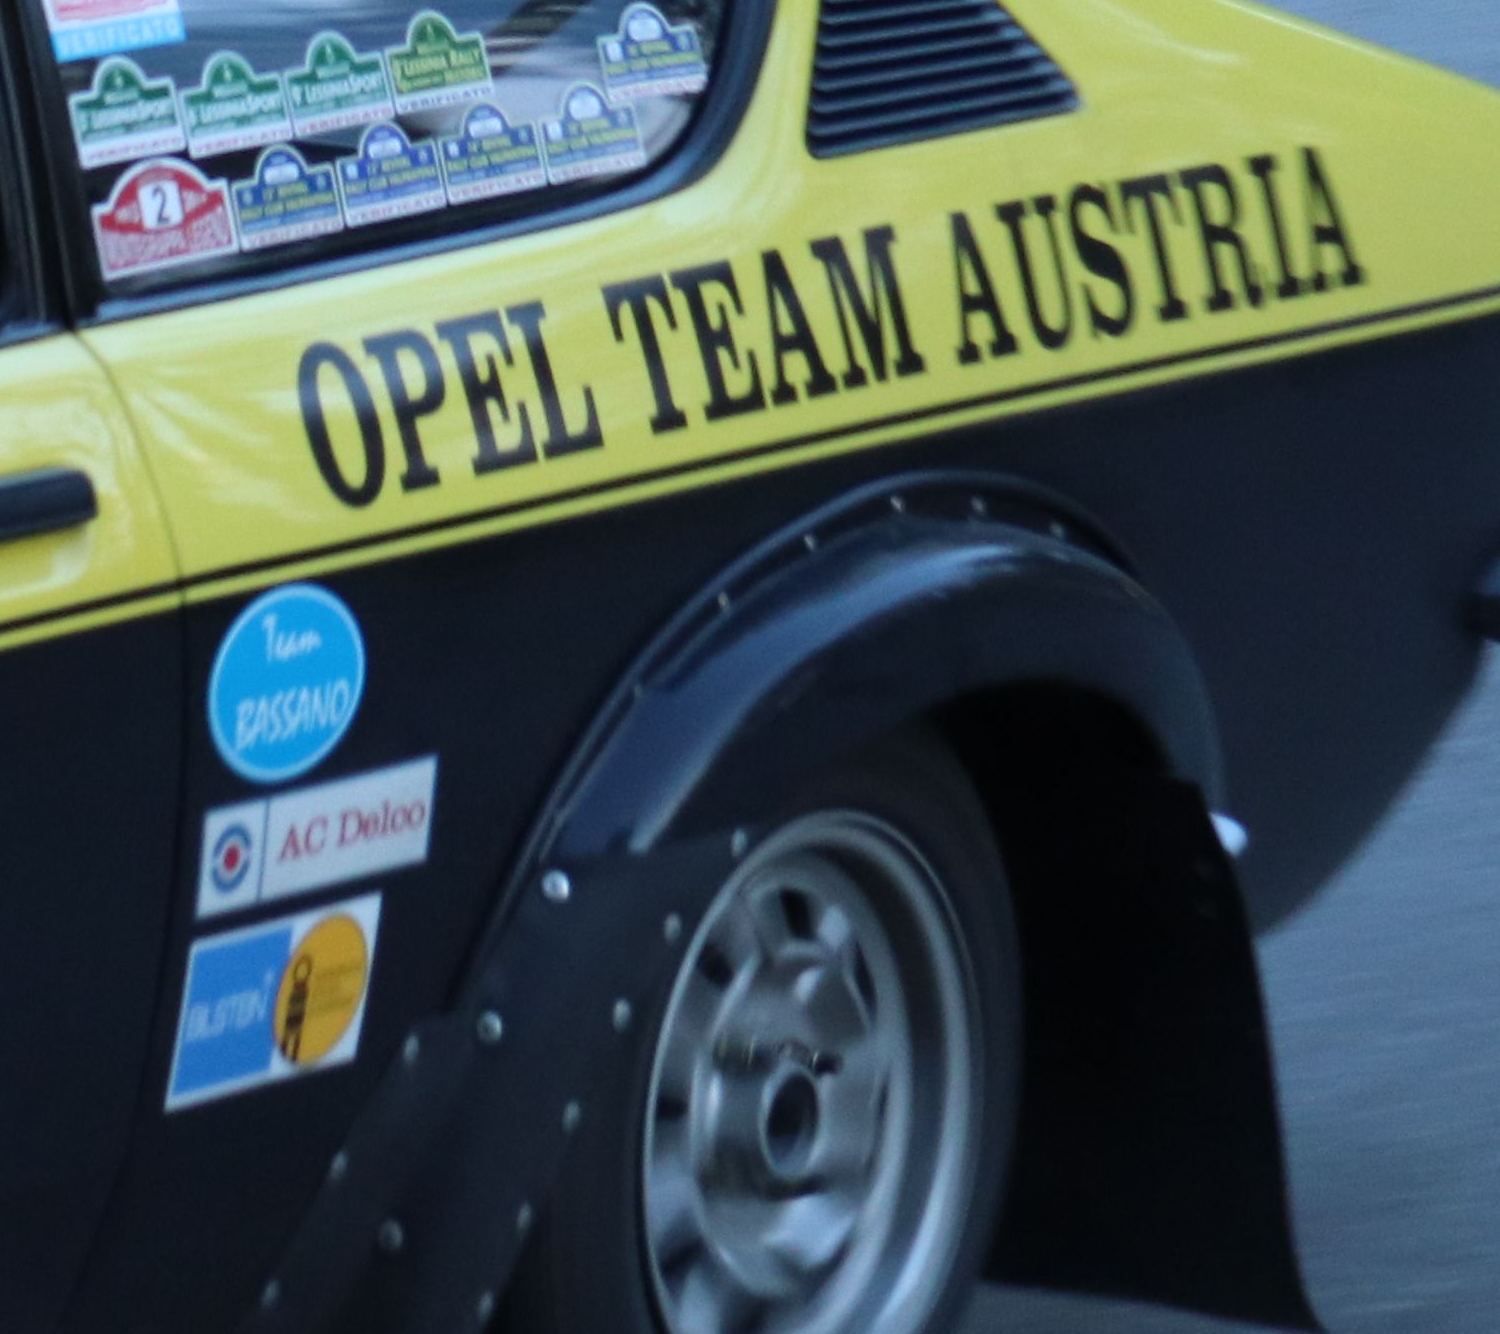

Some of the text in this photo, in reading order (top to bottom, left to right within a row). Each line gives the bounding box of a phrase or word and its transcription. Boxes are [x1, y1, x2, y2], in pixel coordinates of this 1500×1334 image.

[398, 86, 494, 111] VERIFICATO
[152, 186, 171, 225] 2
[298, 145, 1368, 509] OPEL TEAM AUSTRIA
[261, 612, 323, 663] Team
[234, 677, 350, 753] BASSANO
[277, 799, 427, 864] AC Delco
